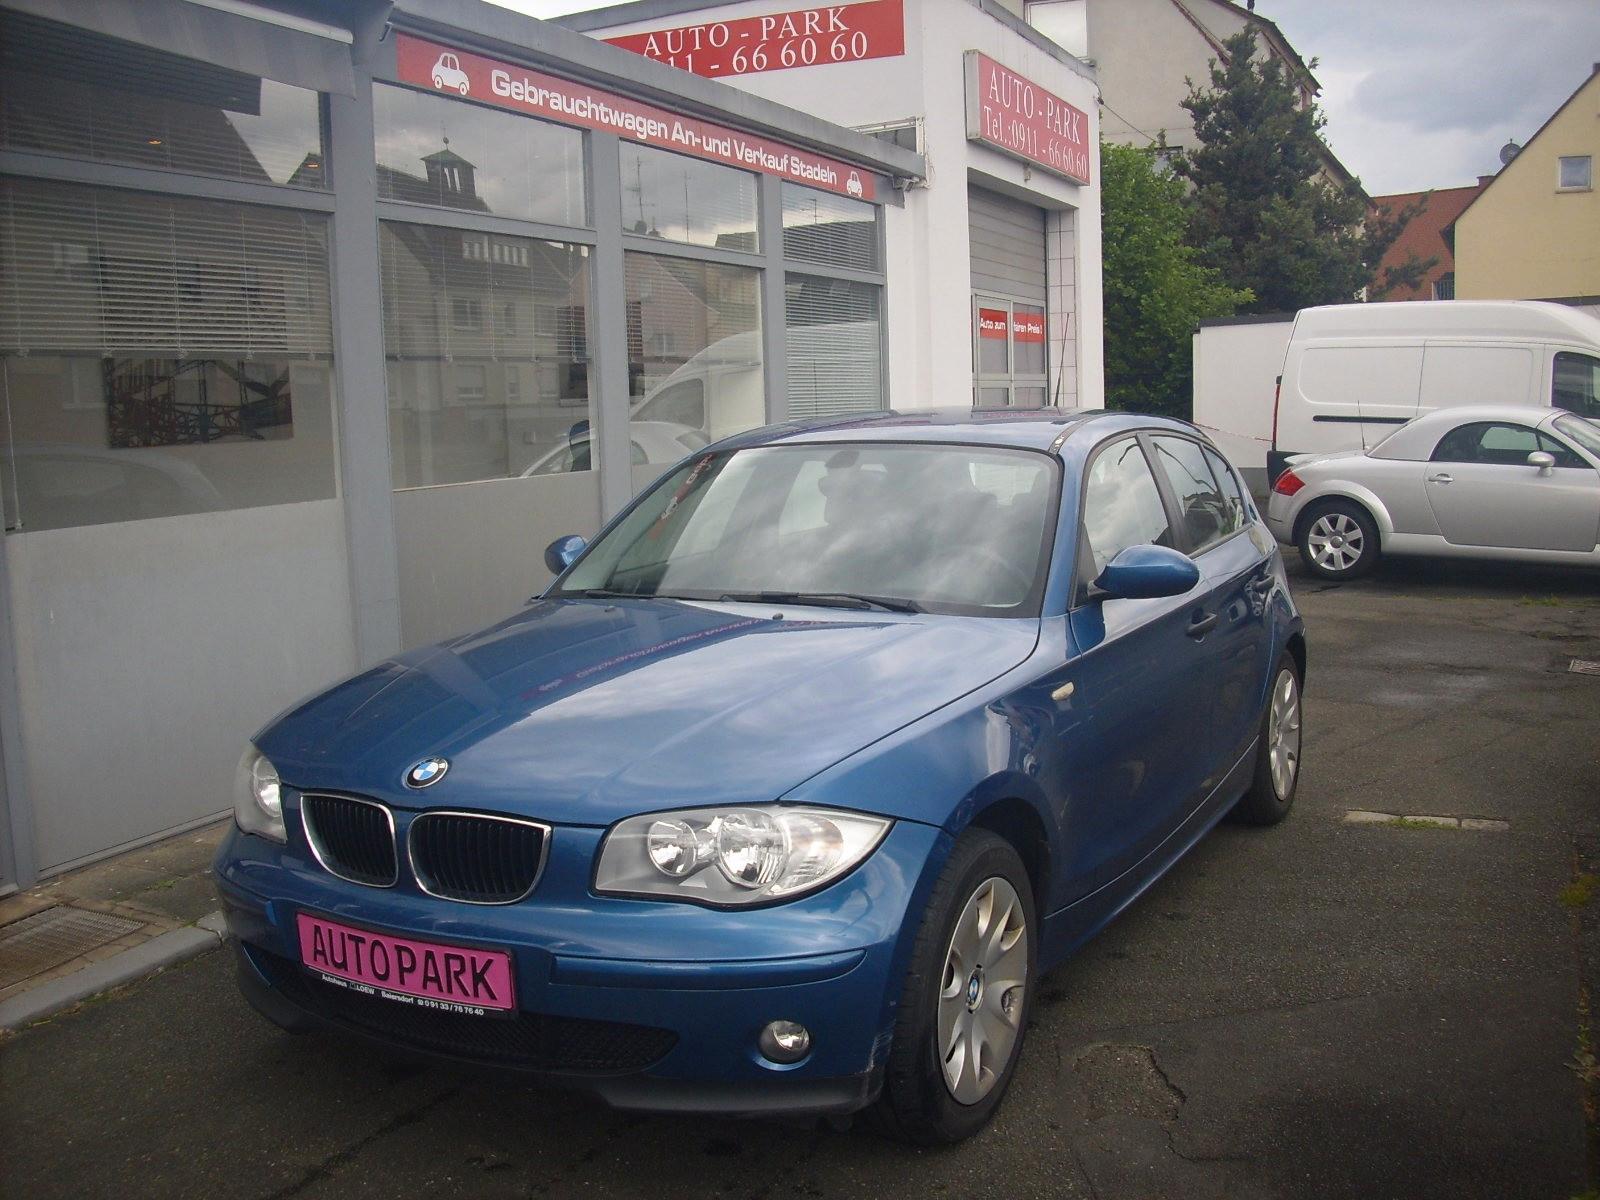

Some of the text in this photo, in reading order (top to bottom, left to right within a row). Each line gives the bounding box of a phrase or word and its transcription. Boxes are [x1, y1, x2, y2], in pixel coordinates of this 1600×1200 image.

[643, 23, 729, 58] AUTO
[760, 6, 850, 41] PARK
[732, 43, 768, 73] 66
[780, 37, 817, 67] 60
[829, 31, 868, 58] 60
[491, 69, 668, 139] Gebrauchtwagen
[733, 139, 789, 172] Verkauf
[790, 156, 837, 184] Stadeln
[988, 65, 1034, 119] AUTO
[1046, 97, 1081, 144] PARK
[1048, 137, 1061, 168] 66
[1063, 145, 1074, 173] 60
[1076, 152, 1087, 179] 60
[980, 317, 993, 330] Auto
[994, 321, 1006, 331] zum
[1013, 321, 1026, 333] fairen
[313, 924, 498, 1001] AUTOPARK
[322, 974, 347, 988] Autohaus
[381, 991, 414, 1004] Baiersdorf
